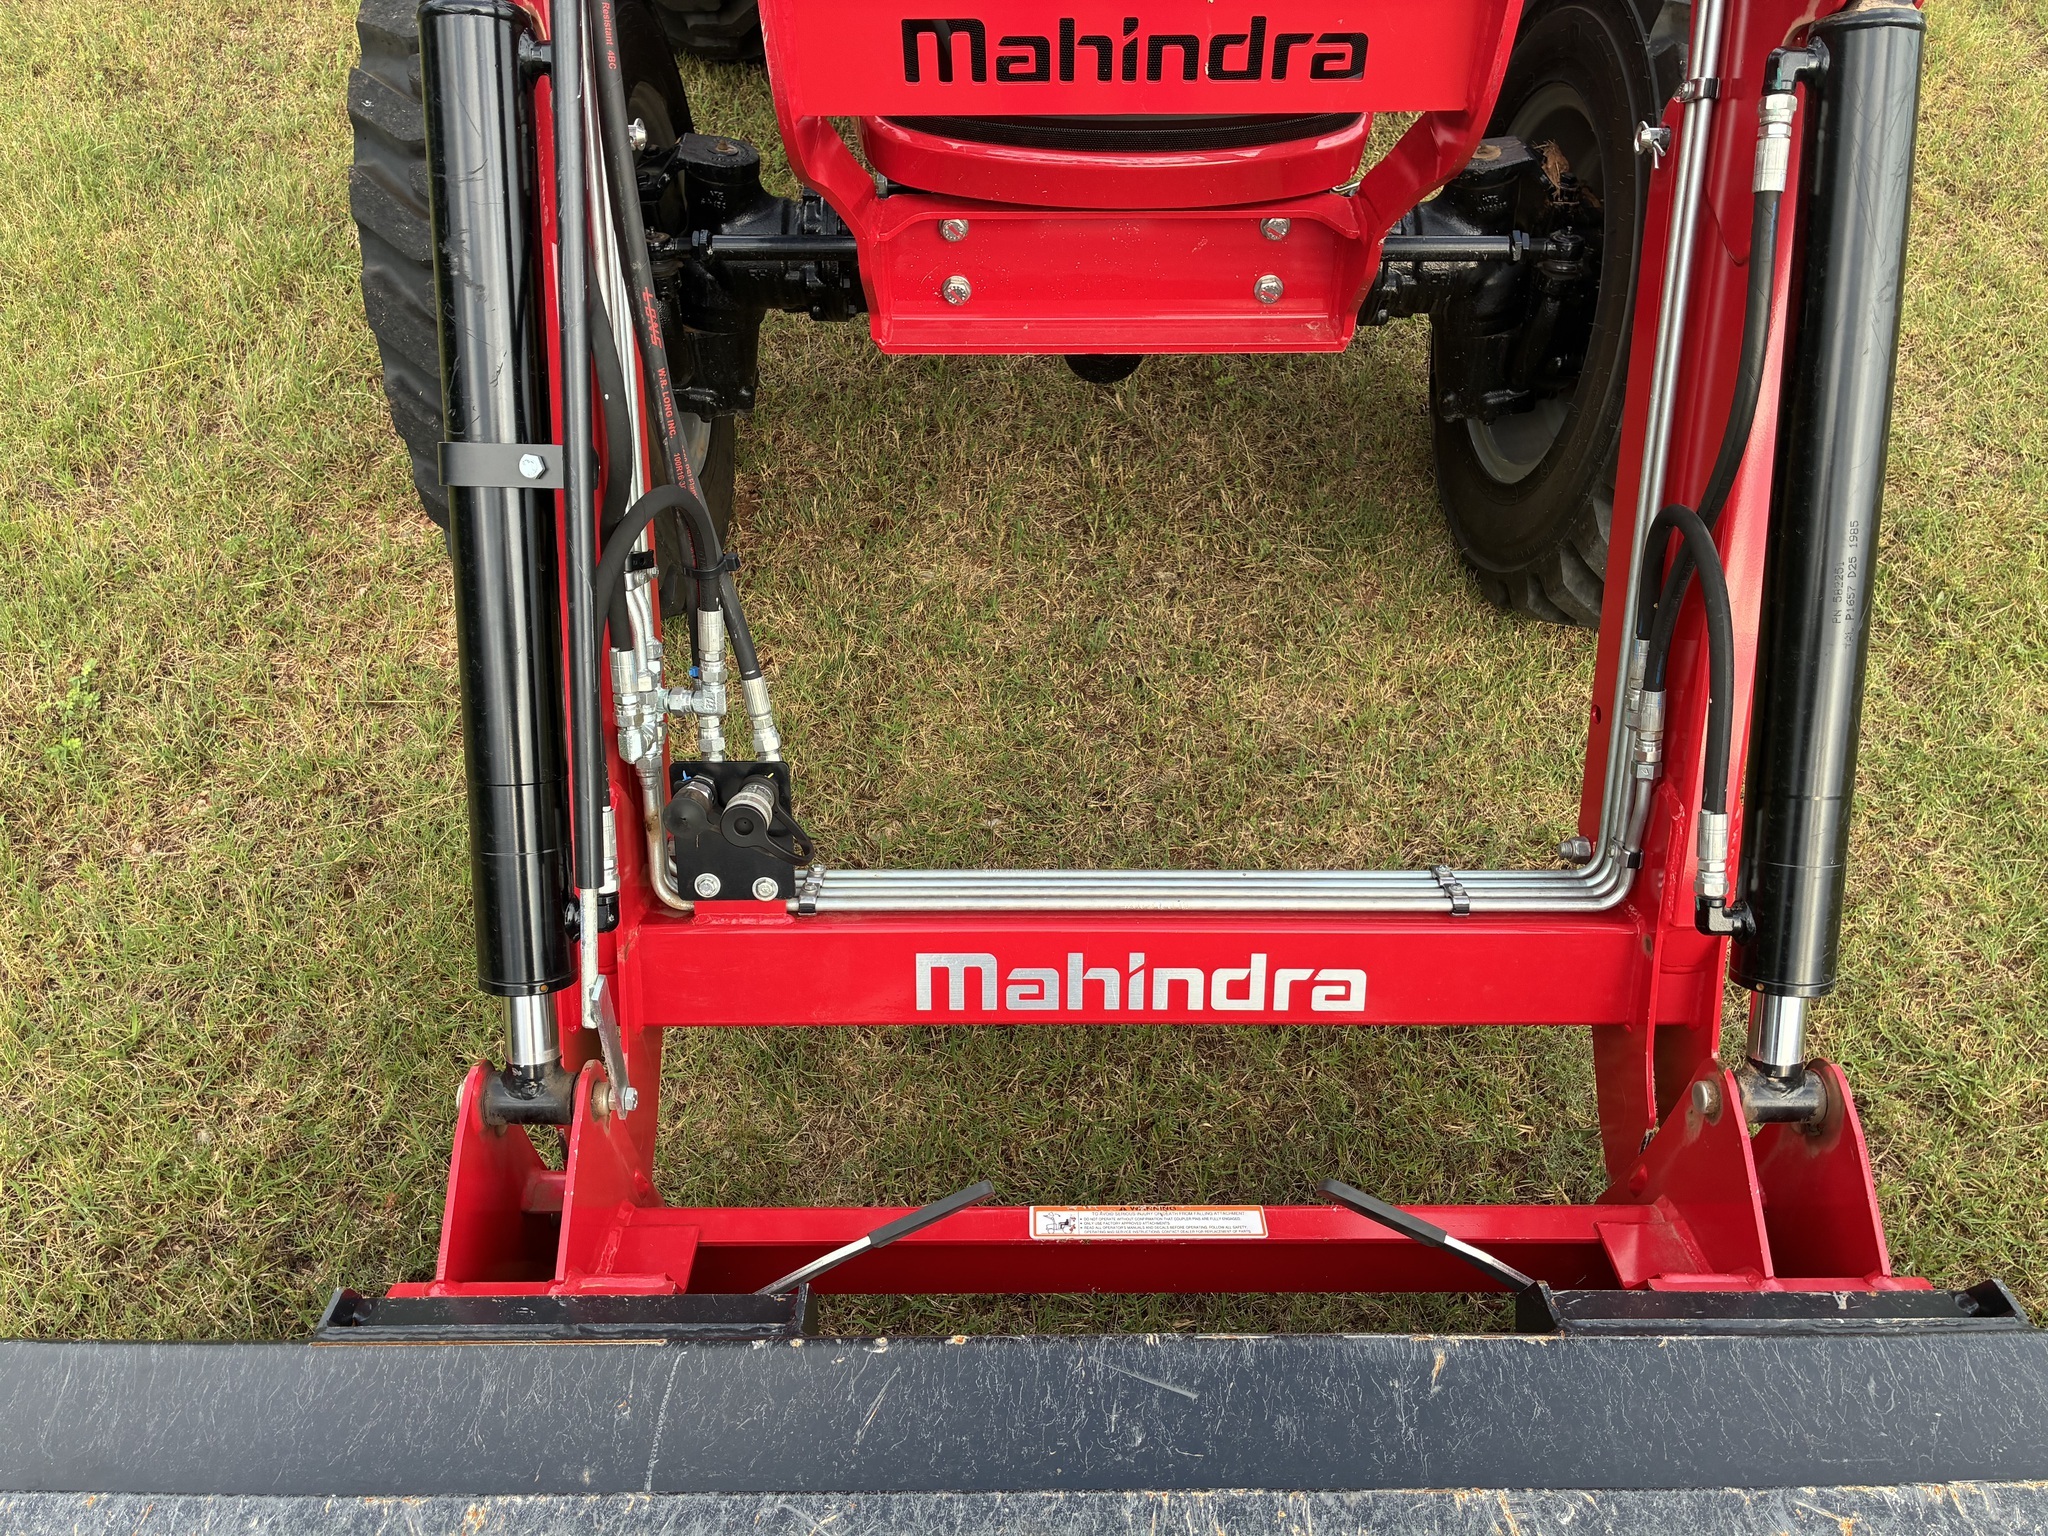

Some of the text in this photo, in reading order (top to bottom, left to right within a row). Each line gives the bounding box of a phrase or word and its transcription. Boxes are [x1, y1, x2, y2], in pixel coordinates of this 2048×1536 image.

[602, 2, 617, 70] Resistant 4BC
[901, 15, 1369, 83] Mahindra
[662, 391, 673, 418] LONG
[667, 419, 677, 439] INC.
[1848, 520, 1860, 549] 1985
[1847, 556, 1858, 578] D25
[1831, 561, 1845, 624] PN 582251
[1845, 586, 1856, 621] P1657
[915, 952, 1367, 1012] Mahindra
